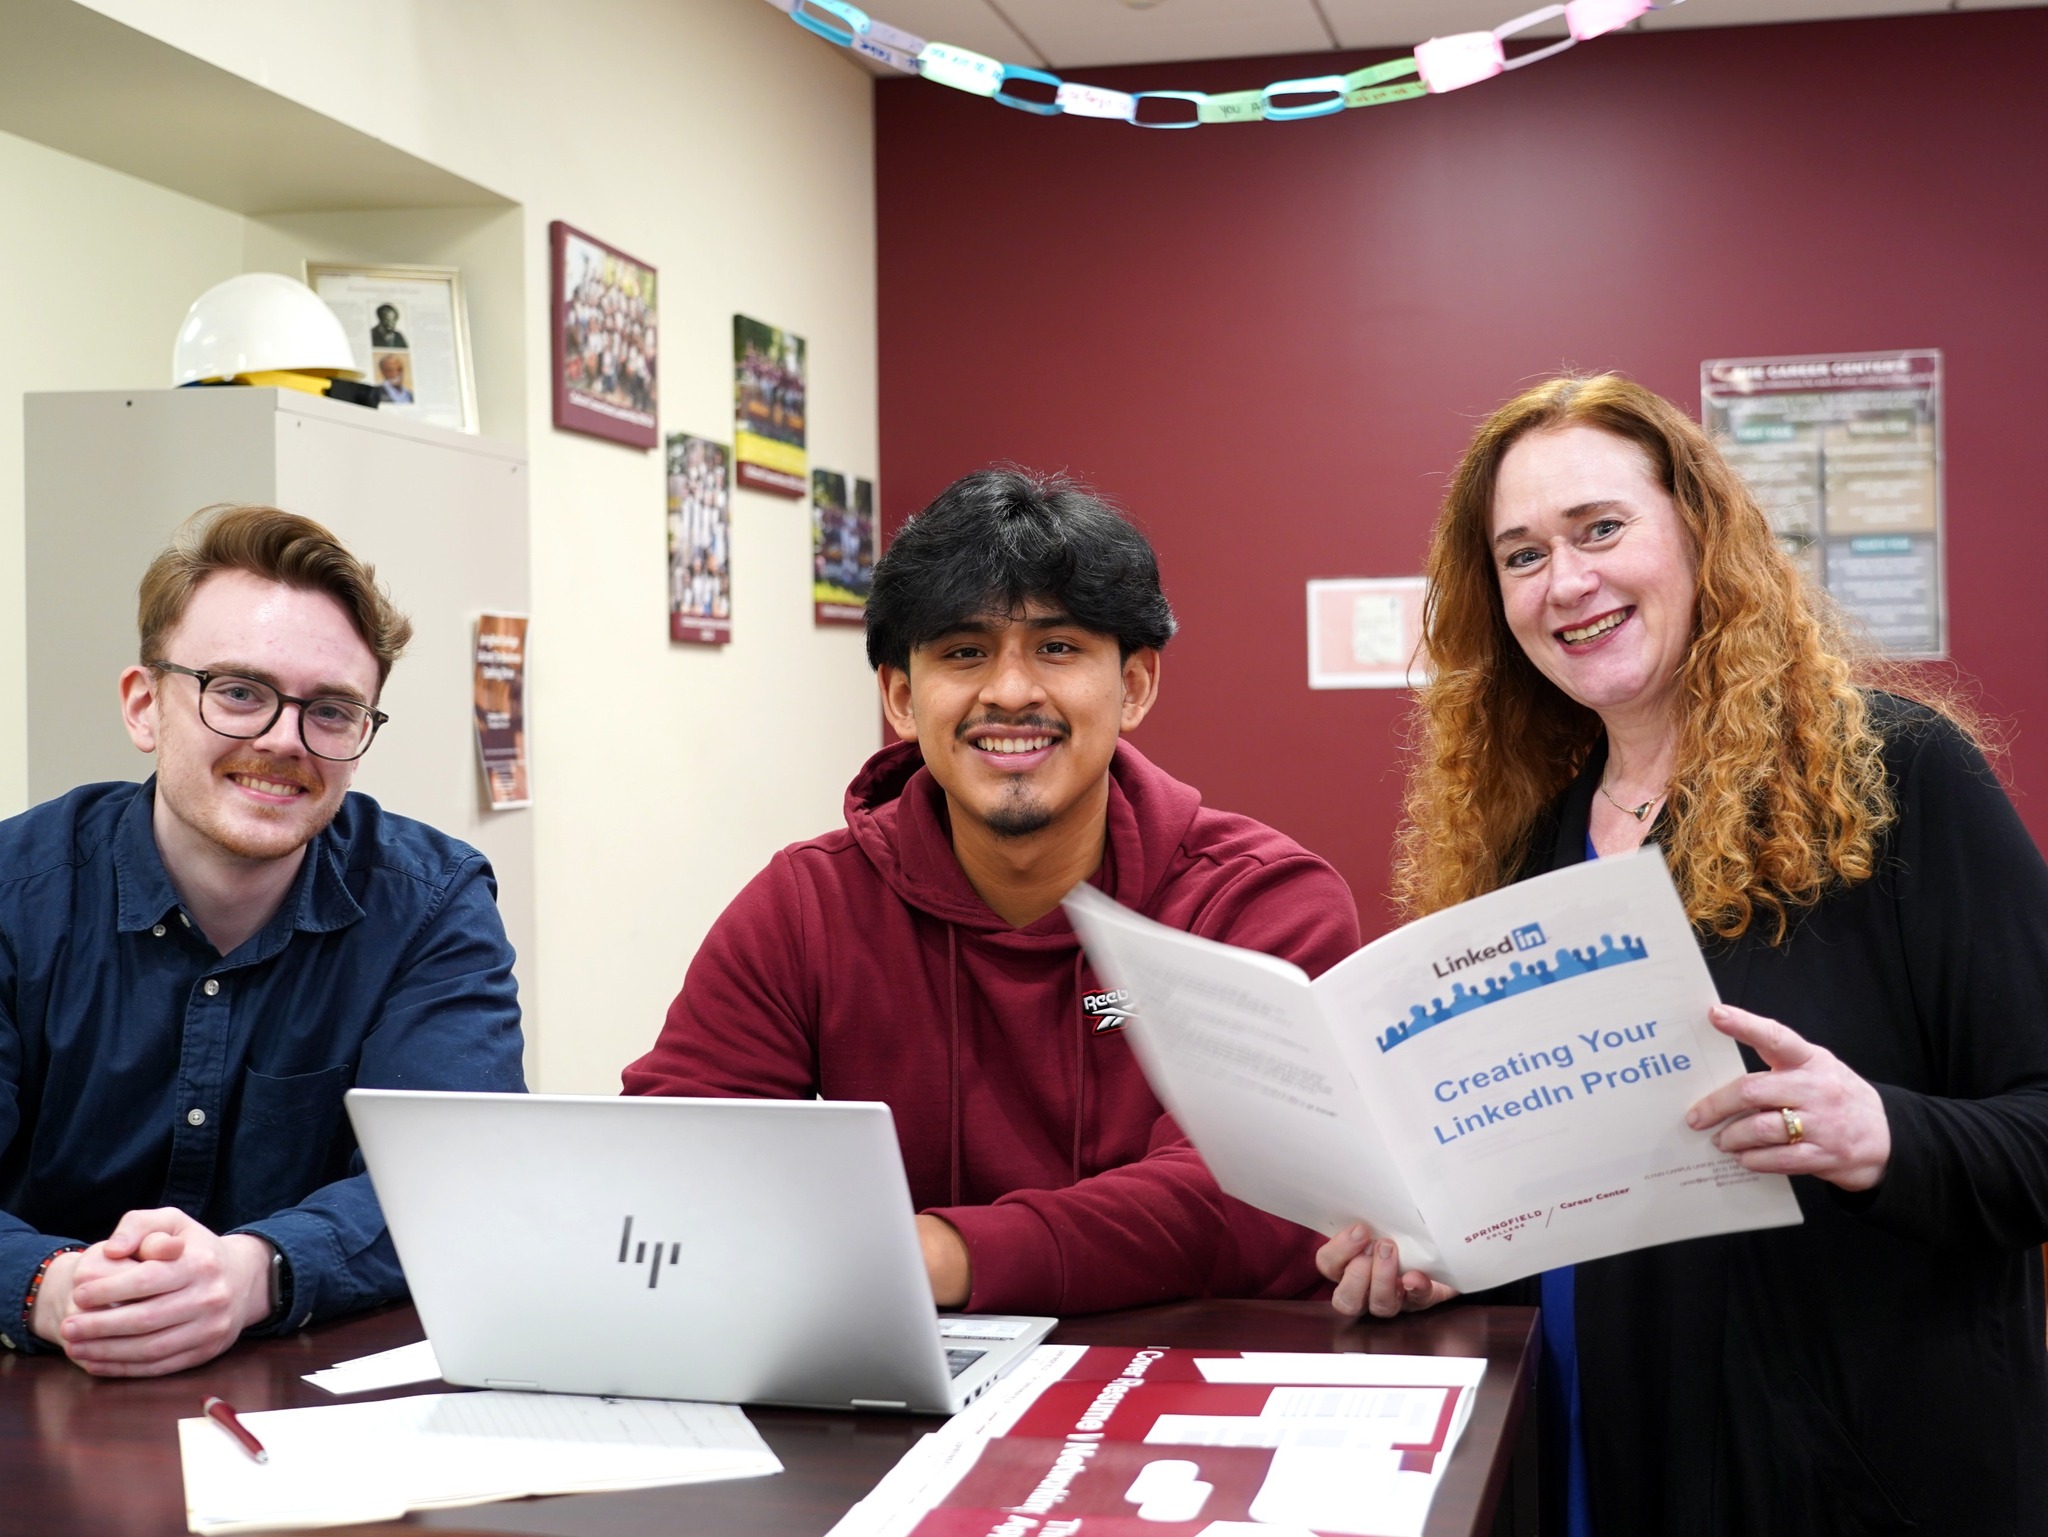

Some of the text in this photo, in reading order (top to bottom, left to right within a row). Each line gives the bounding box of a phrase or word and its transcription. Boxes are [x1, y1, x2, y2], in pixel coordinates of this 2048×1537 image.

[1083, 989, 1129, 1011] Reeb
[1433, 1020, 1658, 1103] Creating Your
[1433, 1053, 1692, 1145] LinkedIn Profile
[1560, 1187, 1630, 1210] Career Center
[1464, 1210, 1542, 1244] SPRINGFIELD
[1075, 1377, 1146, 1432] Resume
